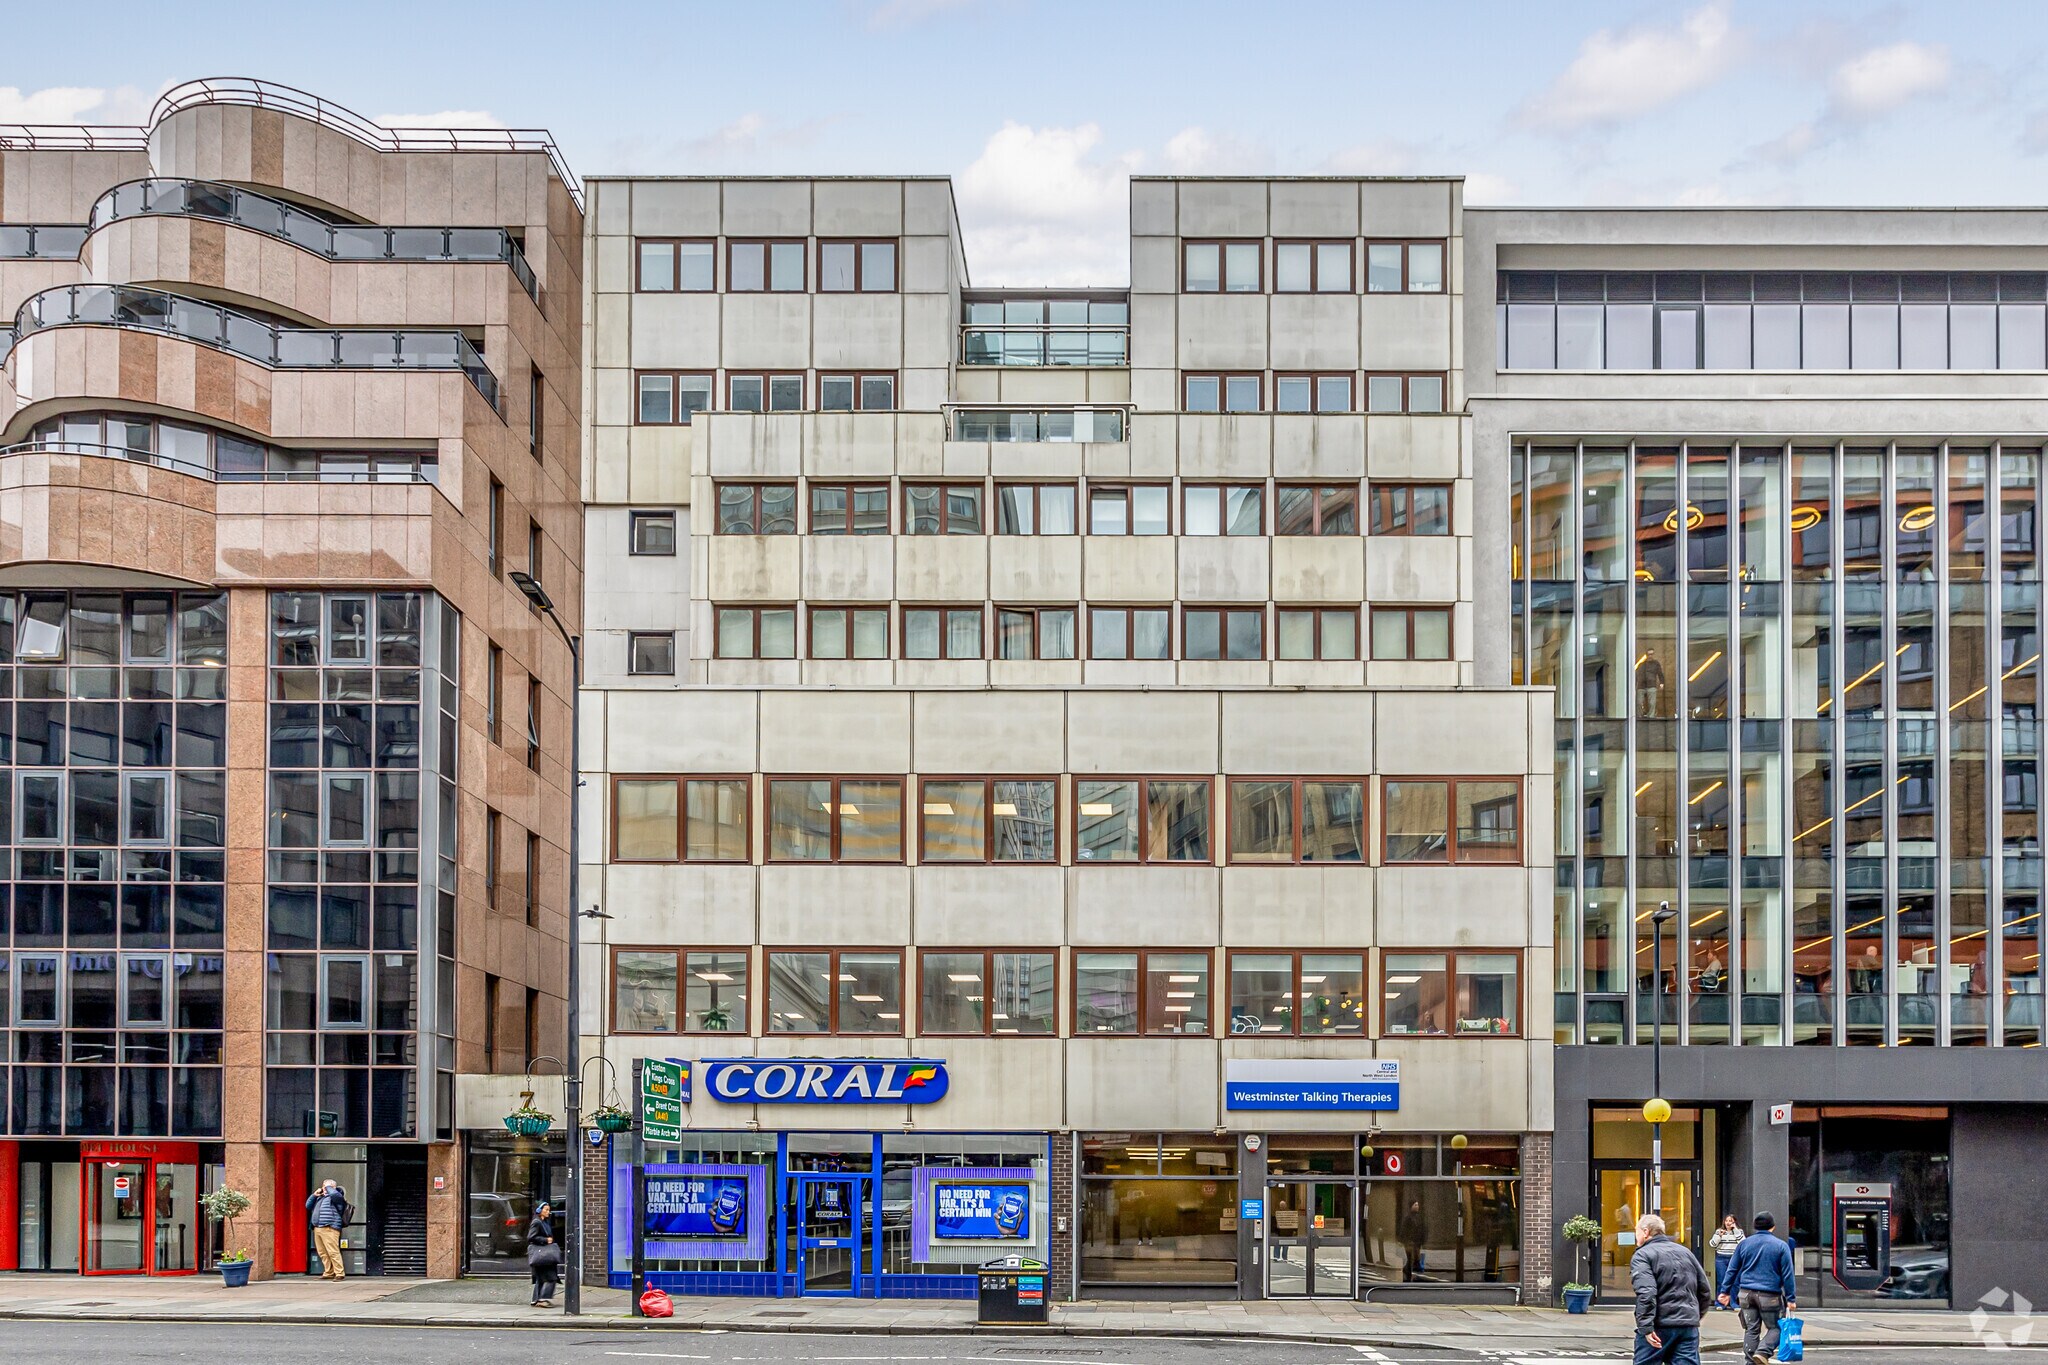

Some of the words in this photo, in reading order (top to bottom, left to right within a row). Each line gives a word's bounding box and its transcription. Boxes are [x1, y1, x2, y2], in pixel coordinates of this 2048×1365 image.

[651, 1062, 666, 1073] Euston
[651, 1073, 663, 1084] Kings
[663, 1075, 676, 1086] Cross
[715, 1064, 903, 1099] CORAL
[520, 1091, 535, 1108] 7
[1234, 1091, 1299, 1102] Westminster
[1302, 1092, 1339, 1104] Talking
[1341, 1092, 1392, 1104] Therapies
[655, 1101, 667, 1111] Brent
[667, 1103, 680, 1113] Cross
[645, 1126, 660, 1136] Marble
[661, 1128, 671, 1137] Arch
[648, 1182, 661, 1193] NO
[663, 1182, 685, 1193] NEED
[687, 1182, 705, 1193] FOR
[648, 1192, 669, 1203] VAR.
[671, 1192, 690, 1203] IT'S
[691, 1193, 698, 1203] A
[940, 1189, 951, 1199] NO
[953, 1189, 973, 1199] NEED
[975, 1189, 990, 1199] FOR
[647, 1203, 686, 1214] CERTAIN
[687, 1203, 706, 1214] WIN
[940, 1199, 959, 1209] VAR.
[960, 1199, 977, 1209] IT'S
[978, 1199, 985, 1209] A
[939, 1208, 973, 1218] CERTAIN
[975, 1208, 992, 1218] WIN
